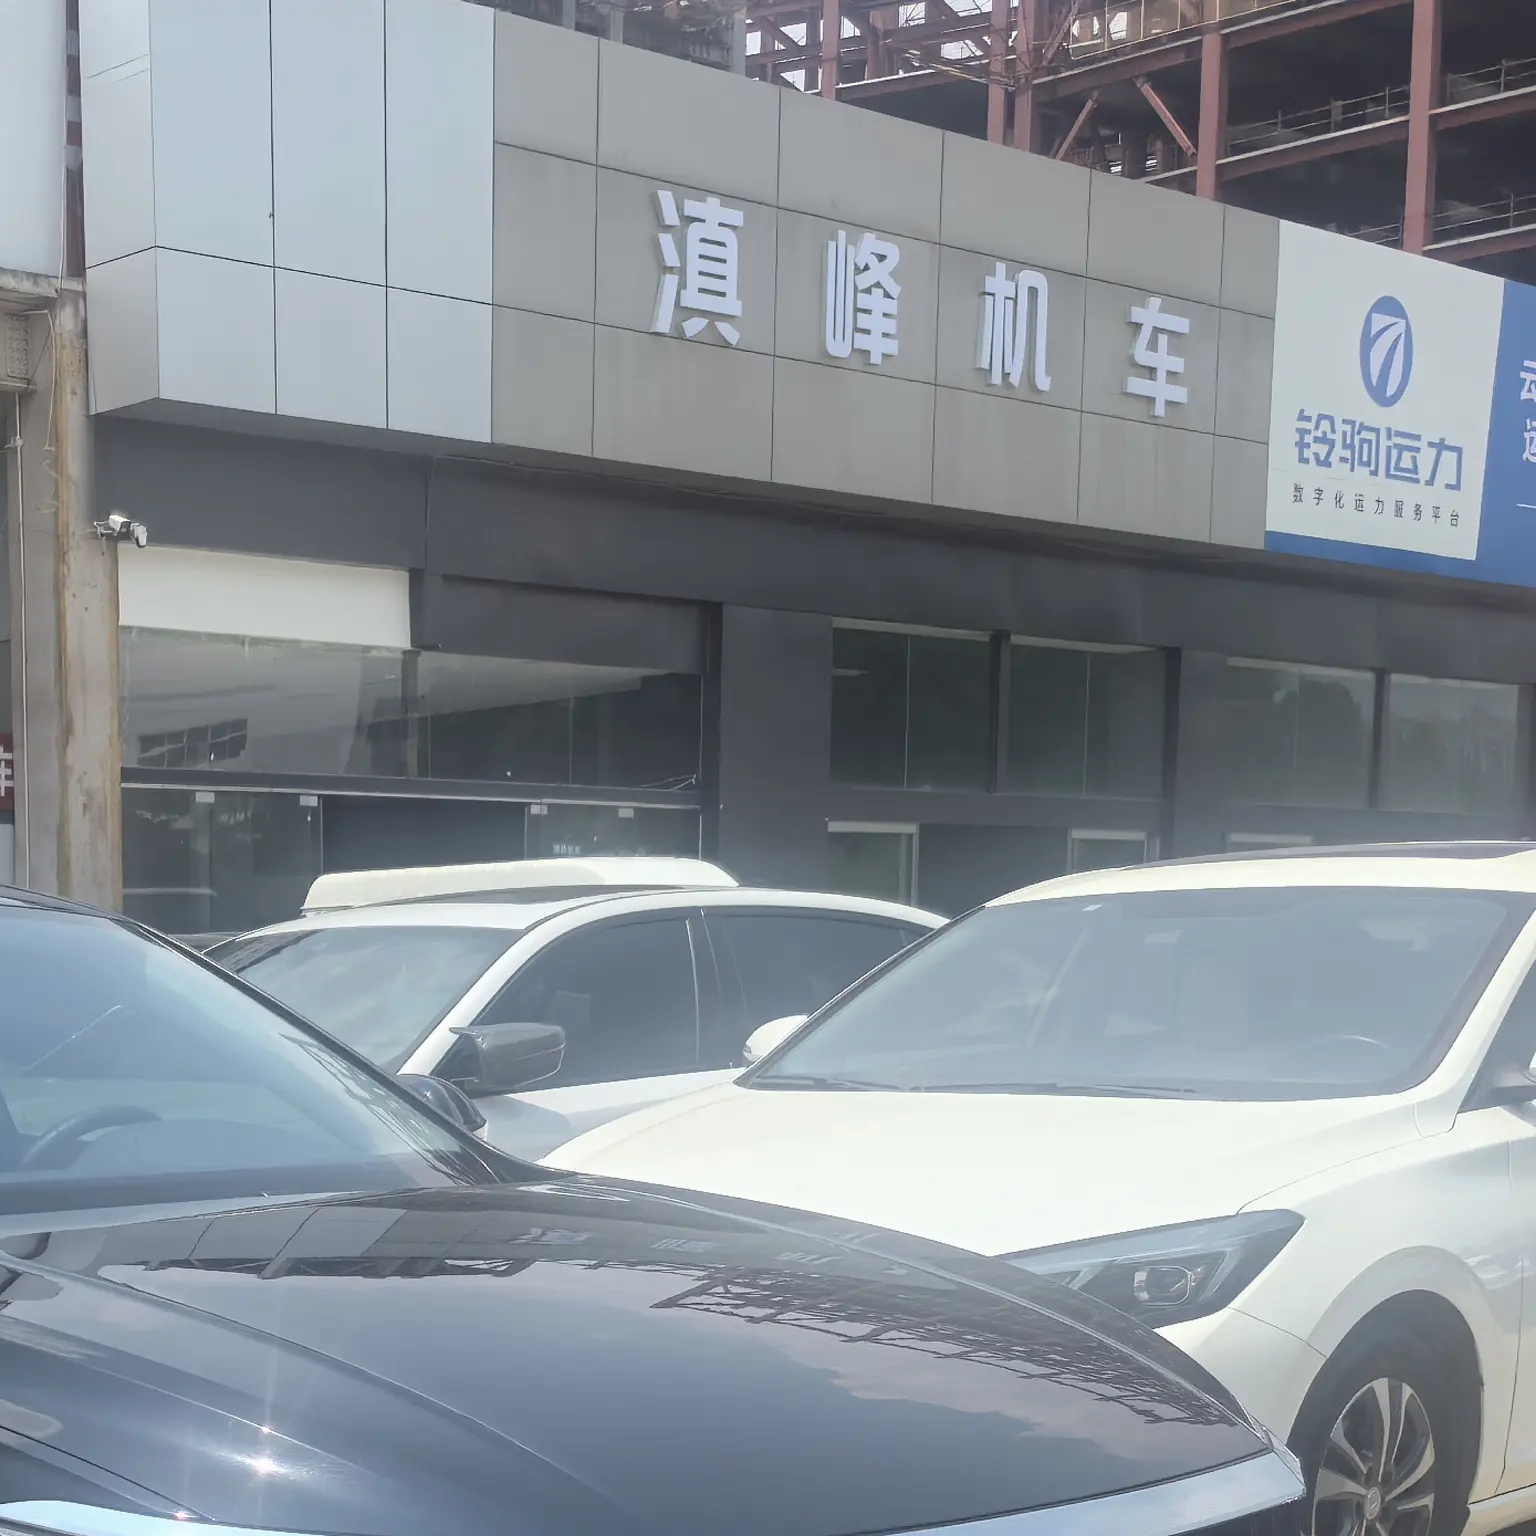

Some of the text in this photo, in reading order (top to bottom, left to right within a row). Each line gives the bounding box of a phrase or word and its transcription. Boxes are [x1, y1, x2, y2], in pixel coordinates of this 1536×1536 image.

[649, 189, 1191, 419] 滇峰机车
[1294, 408, 1464, 492] 铃驹运力
[1292, 482, 1461, 528] 数字化运力服务平台
